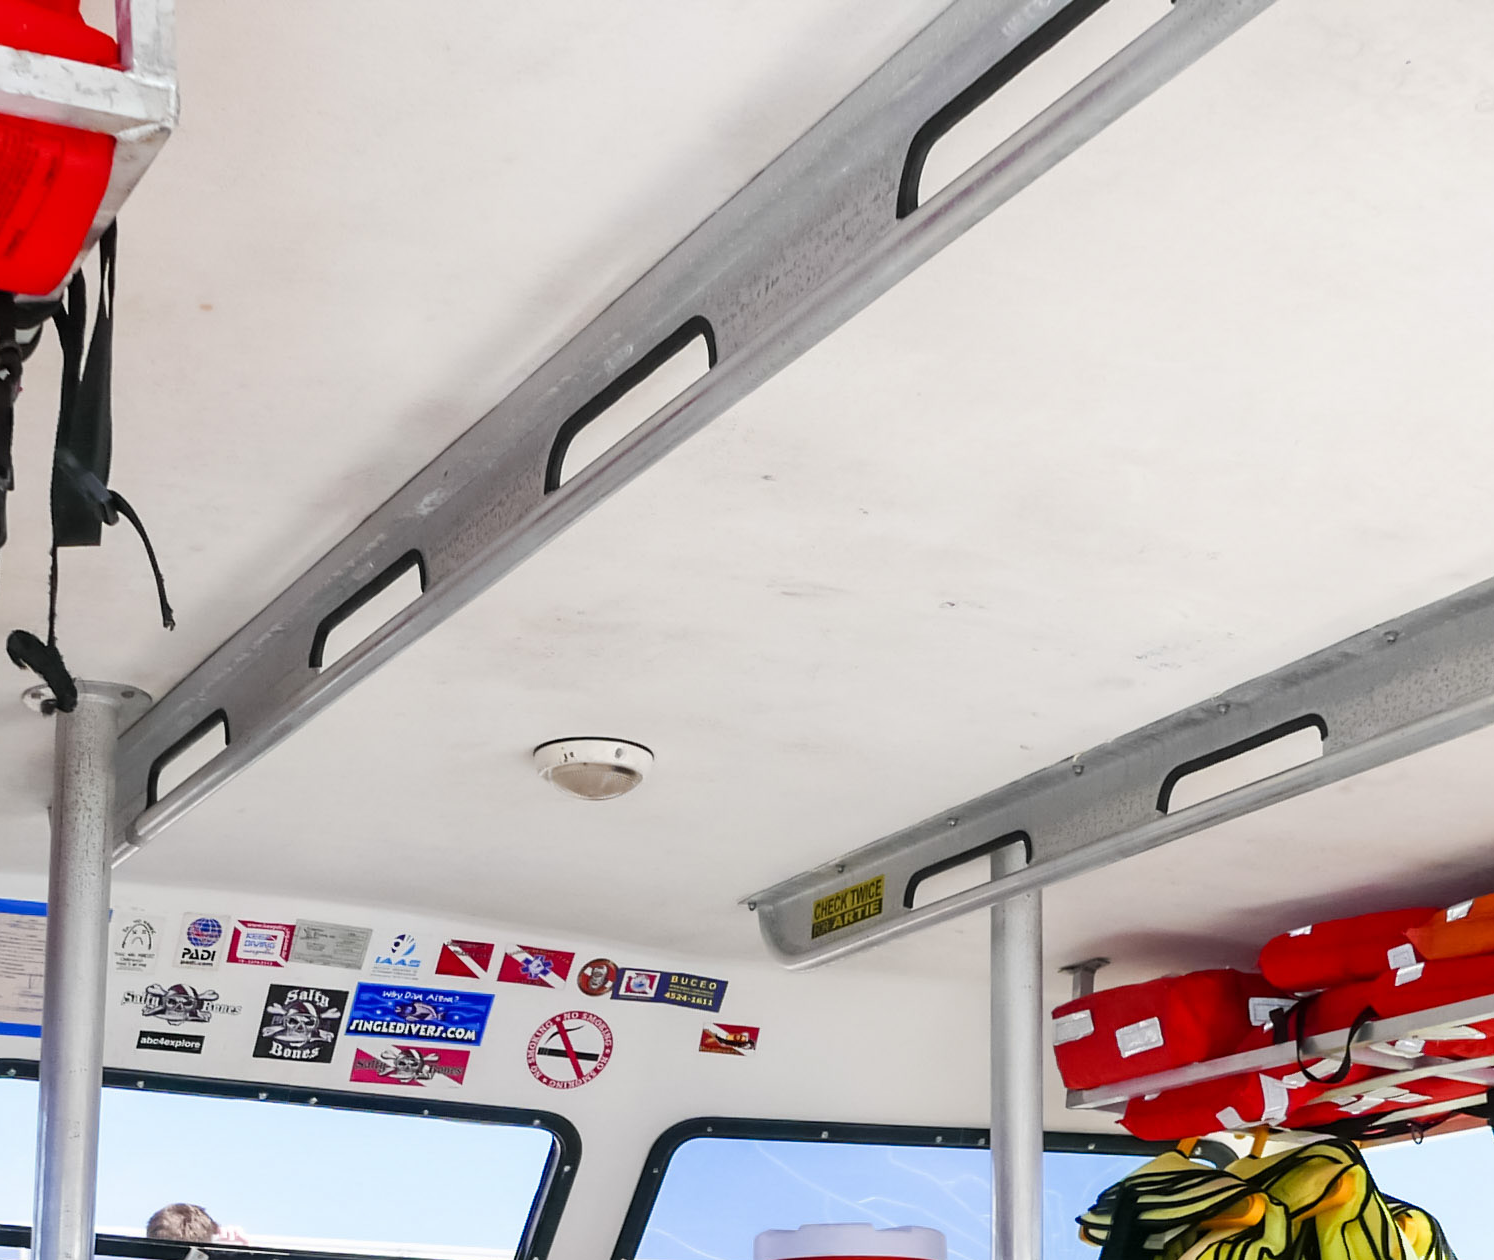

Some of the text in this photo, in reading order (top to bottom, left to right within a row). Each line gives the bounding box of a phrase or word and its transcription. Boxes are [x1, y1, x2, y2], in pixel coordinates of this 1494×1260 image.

[814, 879, 882, 921] CHECK TWICE
[182, 947, 216, 961] PADI
[375, 956, 421, 967] IAAS
[670, 975, 717, 990] BUCEO
[202, 1000, 243, 1016] Bones
[284, 989, 330, 1008] Salty
[349, 1019, 477, 1041] SINGLEDIVERS.COM
[563, 1011, 613, 1049] NO SMOKING
[139, 1036, 202, 1049] abc4explore
[269, 1040, 322, 1059] Bones
[527, 1020, 554, 1064] SMOKING
